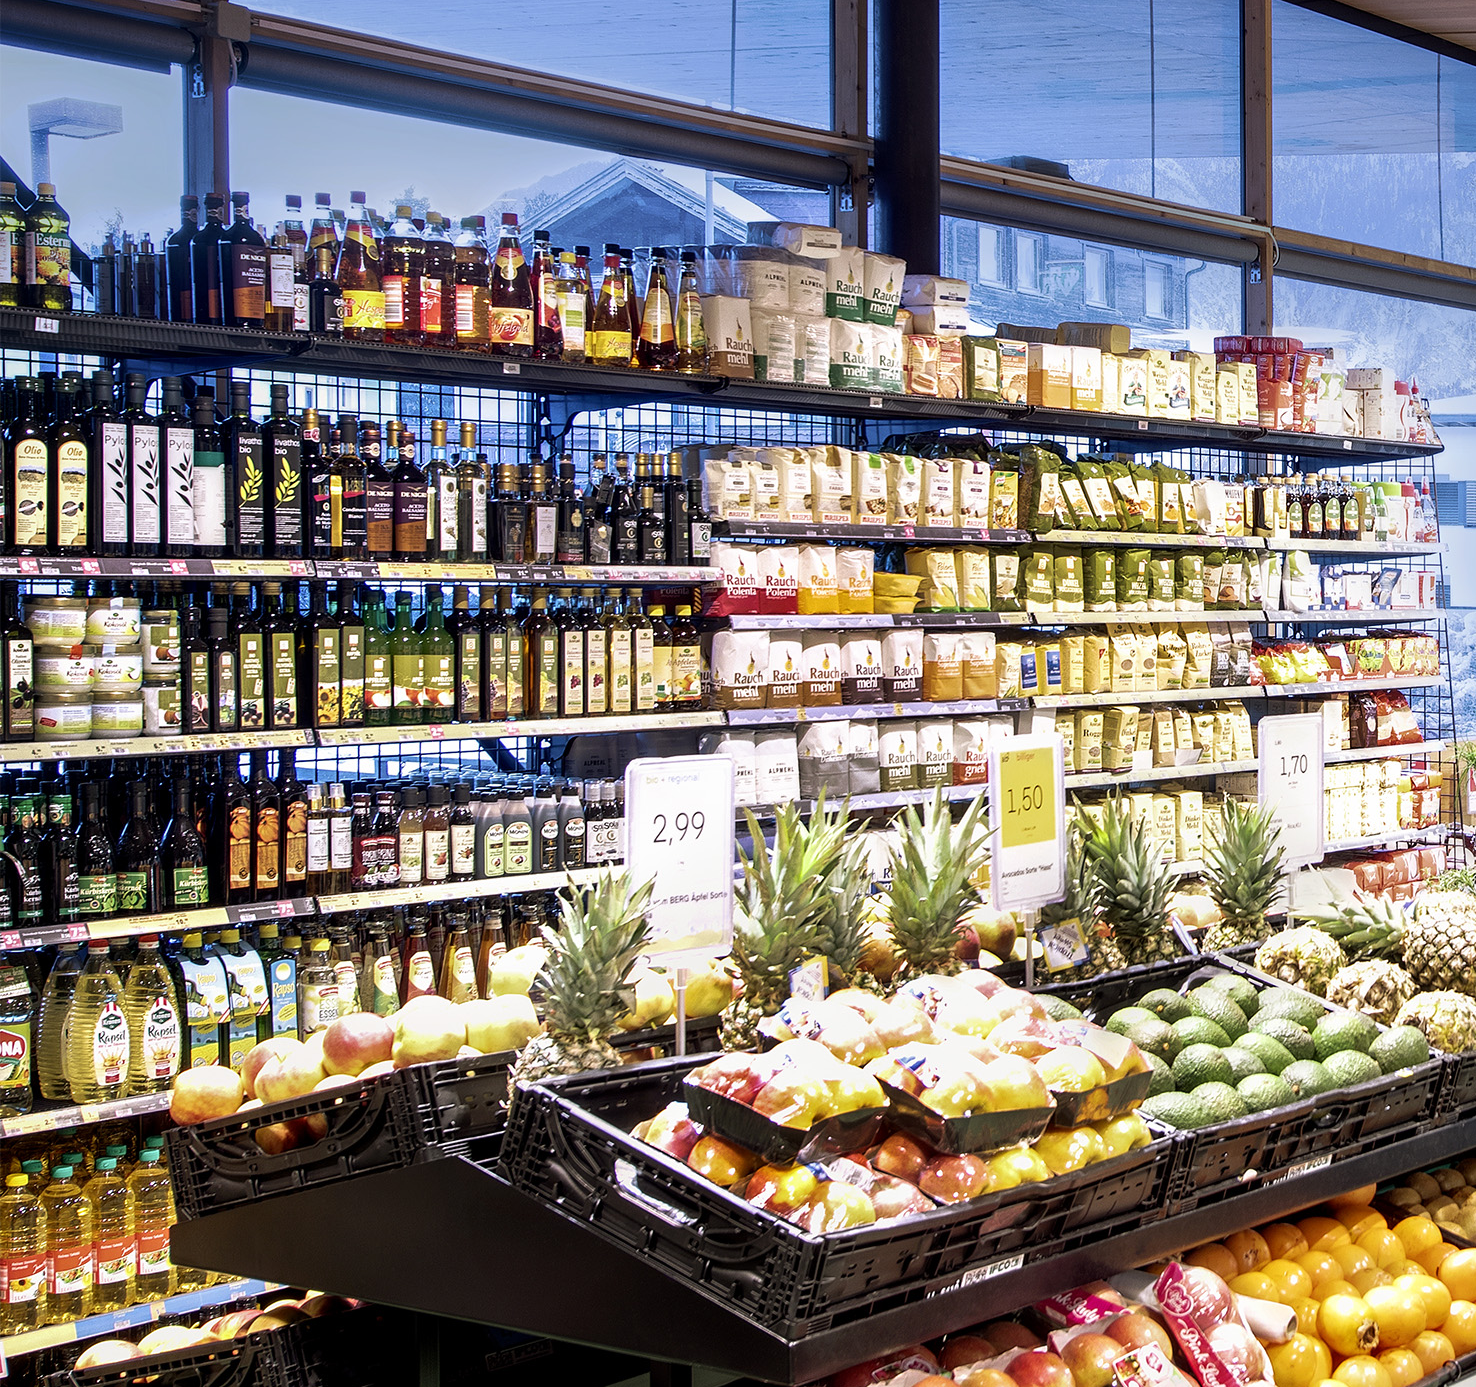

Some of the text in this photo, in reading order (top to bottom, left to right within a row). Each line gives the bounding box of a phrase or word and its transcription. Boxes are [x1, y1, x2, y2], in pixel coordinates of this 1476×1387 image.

[836, 280, 862, 294] Rauch
[836, 294, 857, 307] mehl
[872, 288, 900, 304] Rauch
[870, 302, 894, 315] mehl
[726, 337, 752, 351] Rauch
[727, 353, 749, 365] mehl
[843, 365, 868, 377] mehl
[1077, 389, 1096, 398] mehl
[23, 446, 42, 455] Olio
[67, 447, 83, 456] Olio
[727, 575, 756, 585] Rauch
[766, 576, 796, 587] Rauch
[811, 575, 837, 586] Rauch
[727, 587, 757, 596] Polenta
[766, 588, 796, 596] Polenta
[811, 588, 837, 596] Polenta
[810, 667, 840, 679] Rauch
[856, 664, 882, 675] Rauch
[894, 665, 919, 676] Rauch
[734, 671, 764, 684] Rauch
[856, 677, 878, 688] mehl
[894, 677, 916, 690] mehl
[733, 685, 759, 697] mehl
[773, 682, 796, 694] mehl
[810, 681, 834, 692] mehl
[889, 752, 915, 764] Rauch
[926, 748, 951, 762] Rauch
[966, 751, 988, 763] Rauc
[889, 765, 911, 777] mehl
[926, 763, 948, 775] mehl
[1280, 754, 1308, 777] 1,70
[646, 776, 658, 784] bio
[668, 773, 699, 784] regional
[1007, 785, 1044, 815] 1,50
[653, 811, 705, 846] 2,99
[1001, 869, 1025, 879] Avocados
[1025, 866, 1038, 874] Sorte
[670, 894, 689, 904] BERG
[691, 892, 708, 902] Äpfel
[272, 982, 295, 997] Rapso
[97, 1029, 126, 1045] Rapsöl
[148, 1023, 176, 1040] Rapsöl
[989, 1259, 1010, 1275] IFCO
[1070, 1297, 1100, 1324] Lady
[1178, 1318, 1207, 1364] Pink
